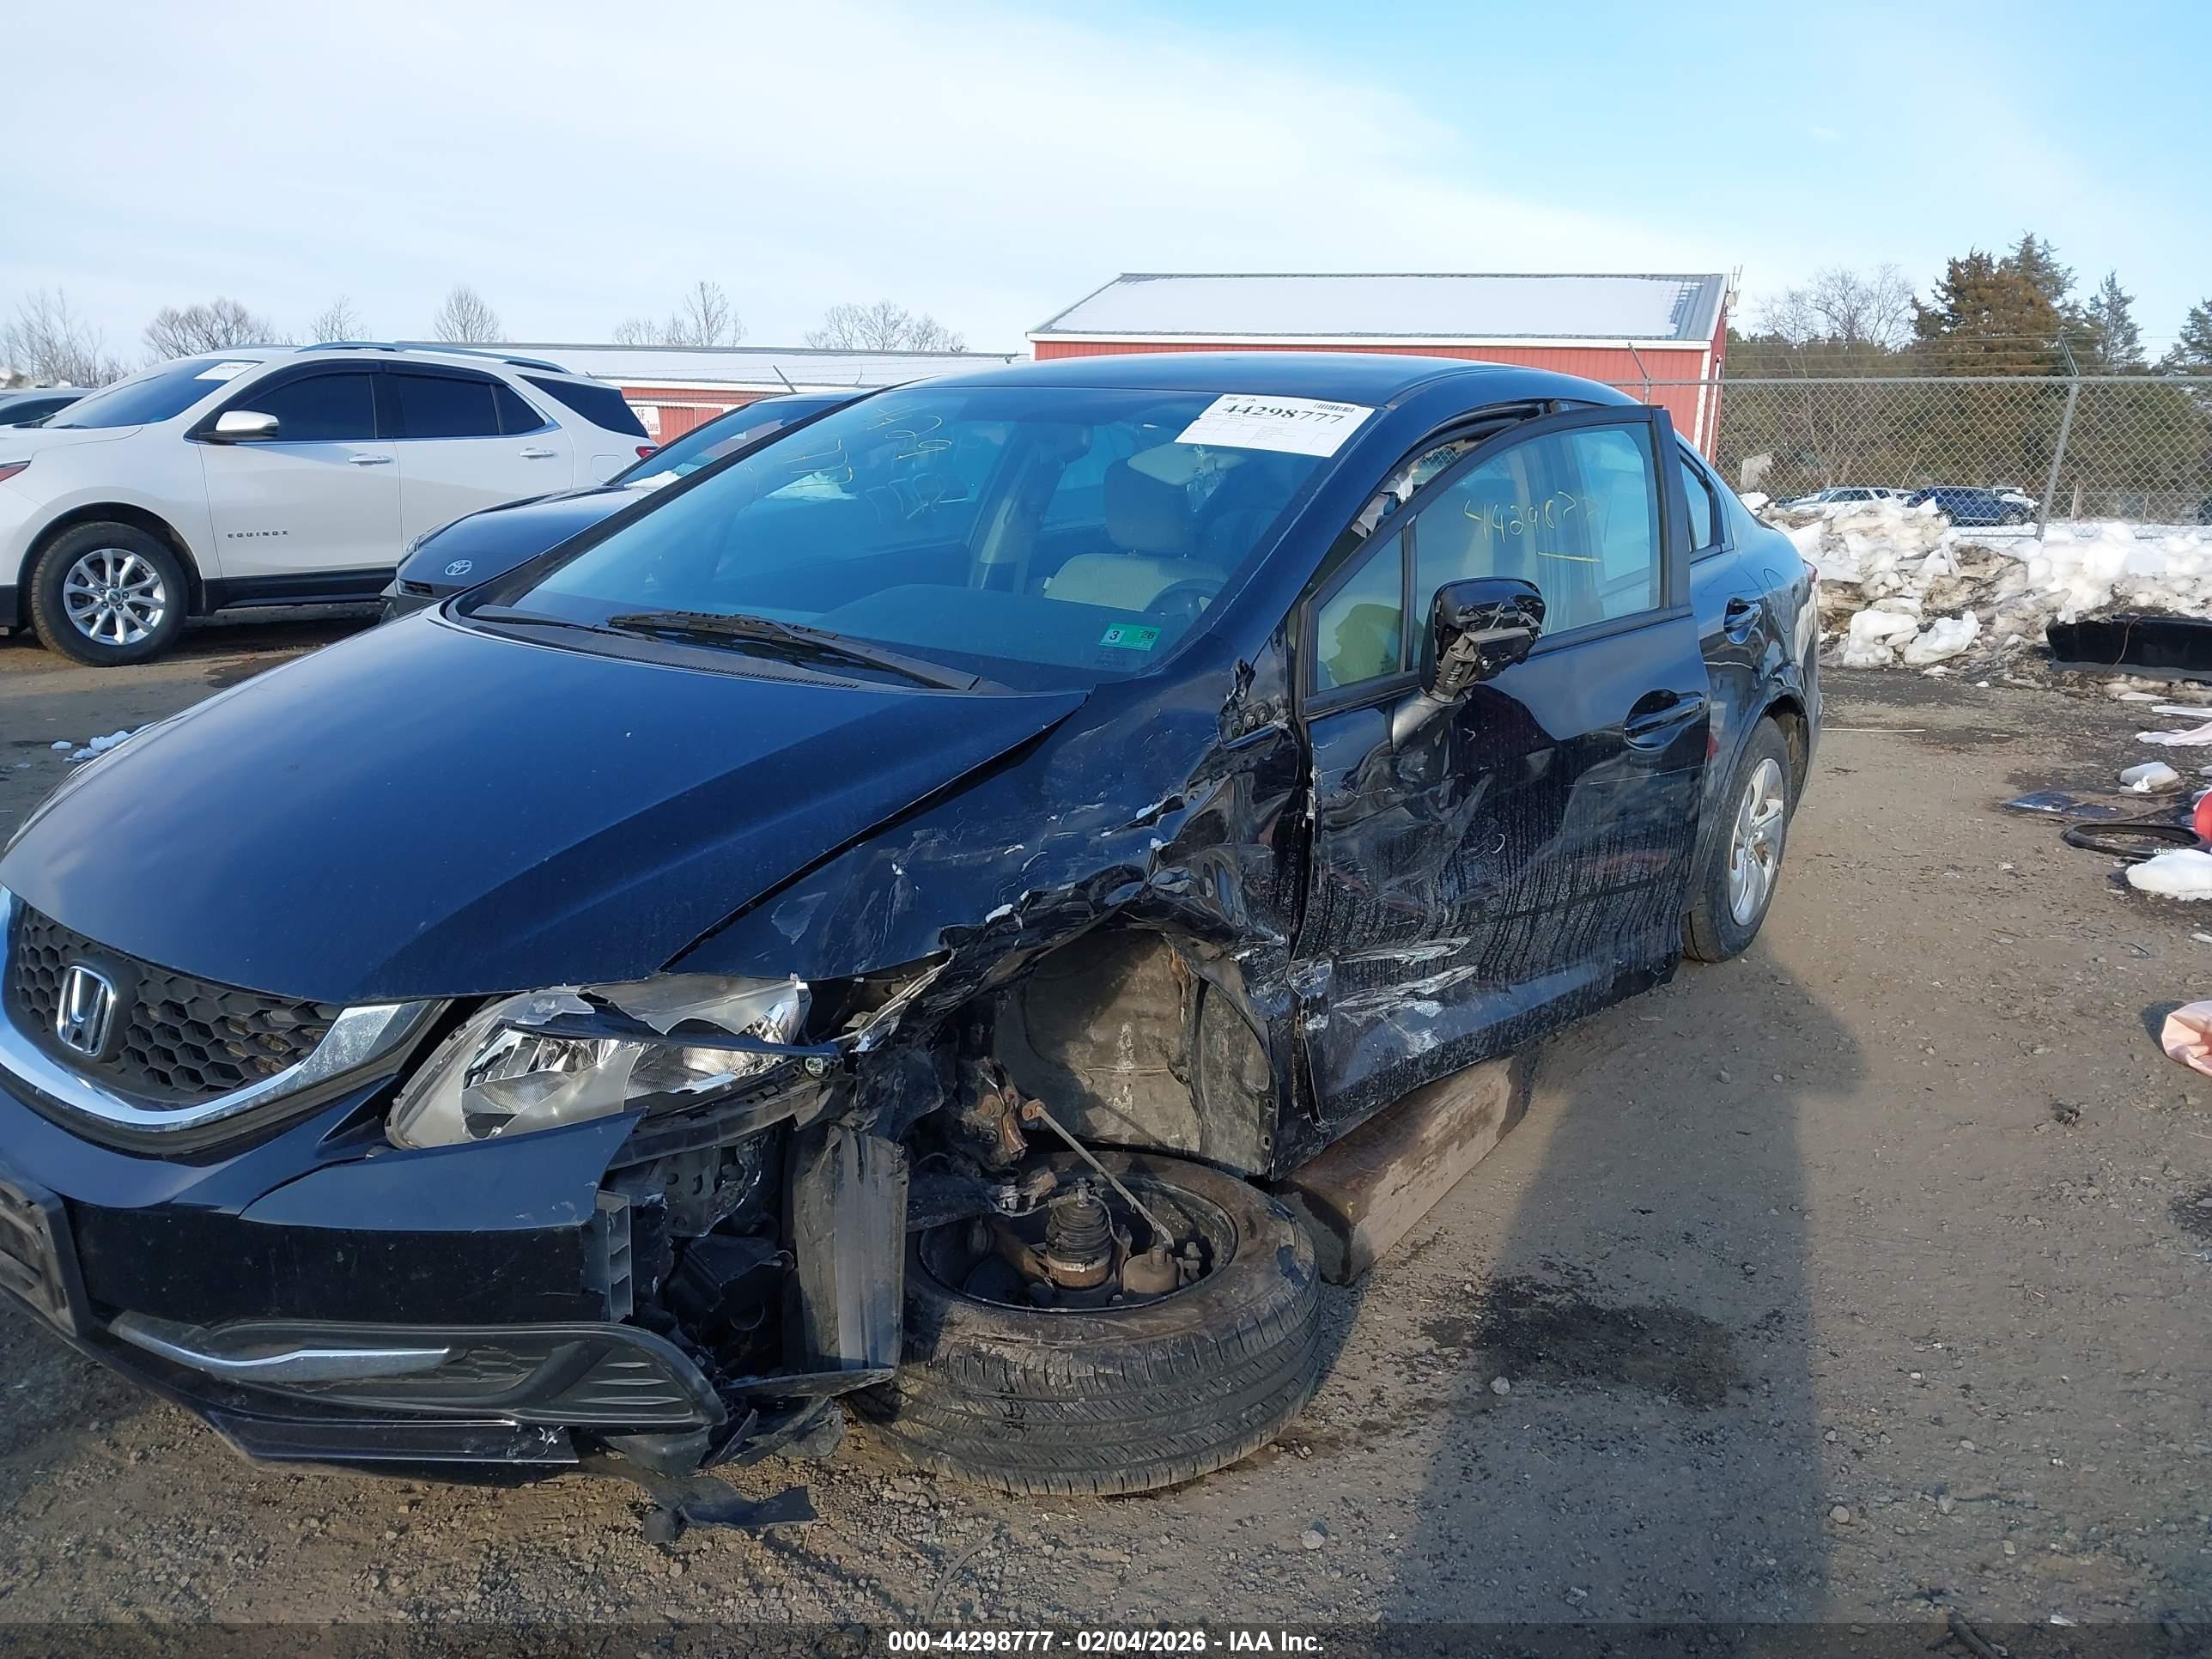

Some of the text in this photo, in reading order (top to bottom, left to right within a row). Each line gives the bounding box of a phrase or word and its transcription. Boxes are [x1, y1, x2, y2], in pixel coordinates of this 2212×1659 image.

[1223, 404, 1346, 424] 44298777
[227, 530, 289, 538] EQUINOX
[1109, 630, 1121, 641] 3
